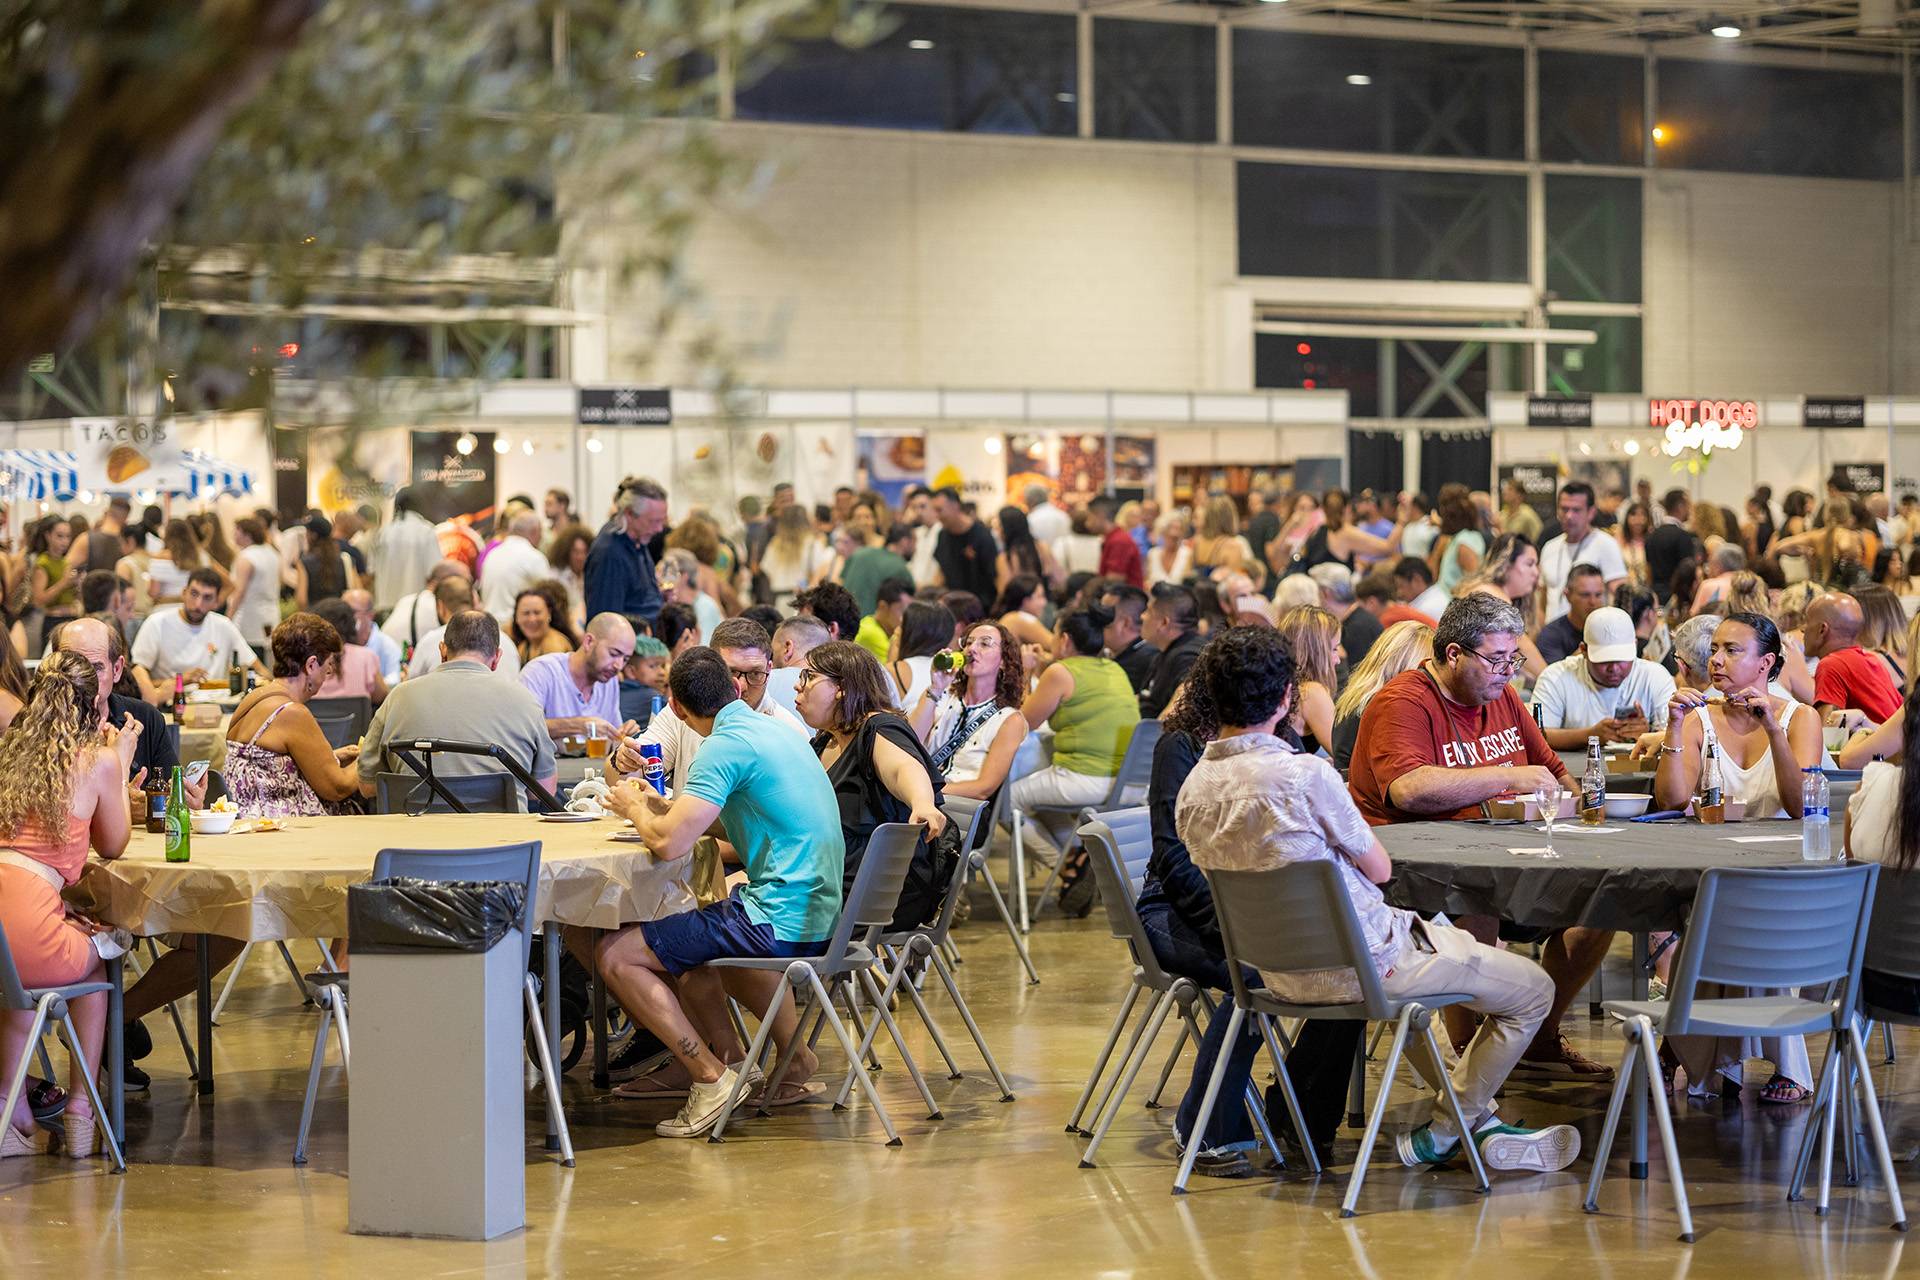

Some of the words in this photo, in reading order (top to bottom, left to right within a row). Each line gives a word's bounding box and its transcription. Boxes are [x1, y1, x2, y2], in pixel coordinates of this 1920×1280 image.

[1650, 400, 1697, 427] HOT
[1700, 400, 1757, 428] DOGS
[82, 423, 167, 445] TACOS
[1442, 741, 1483, 767] ENOY
[1479, 726, 1525, 760] ESCAPE
[644, 763, 664, 773] PEPS
